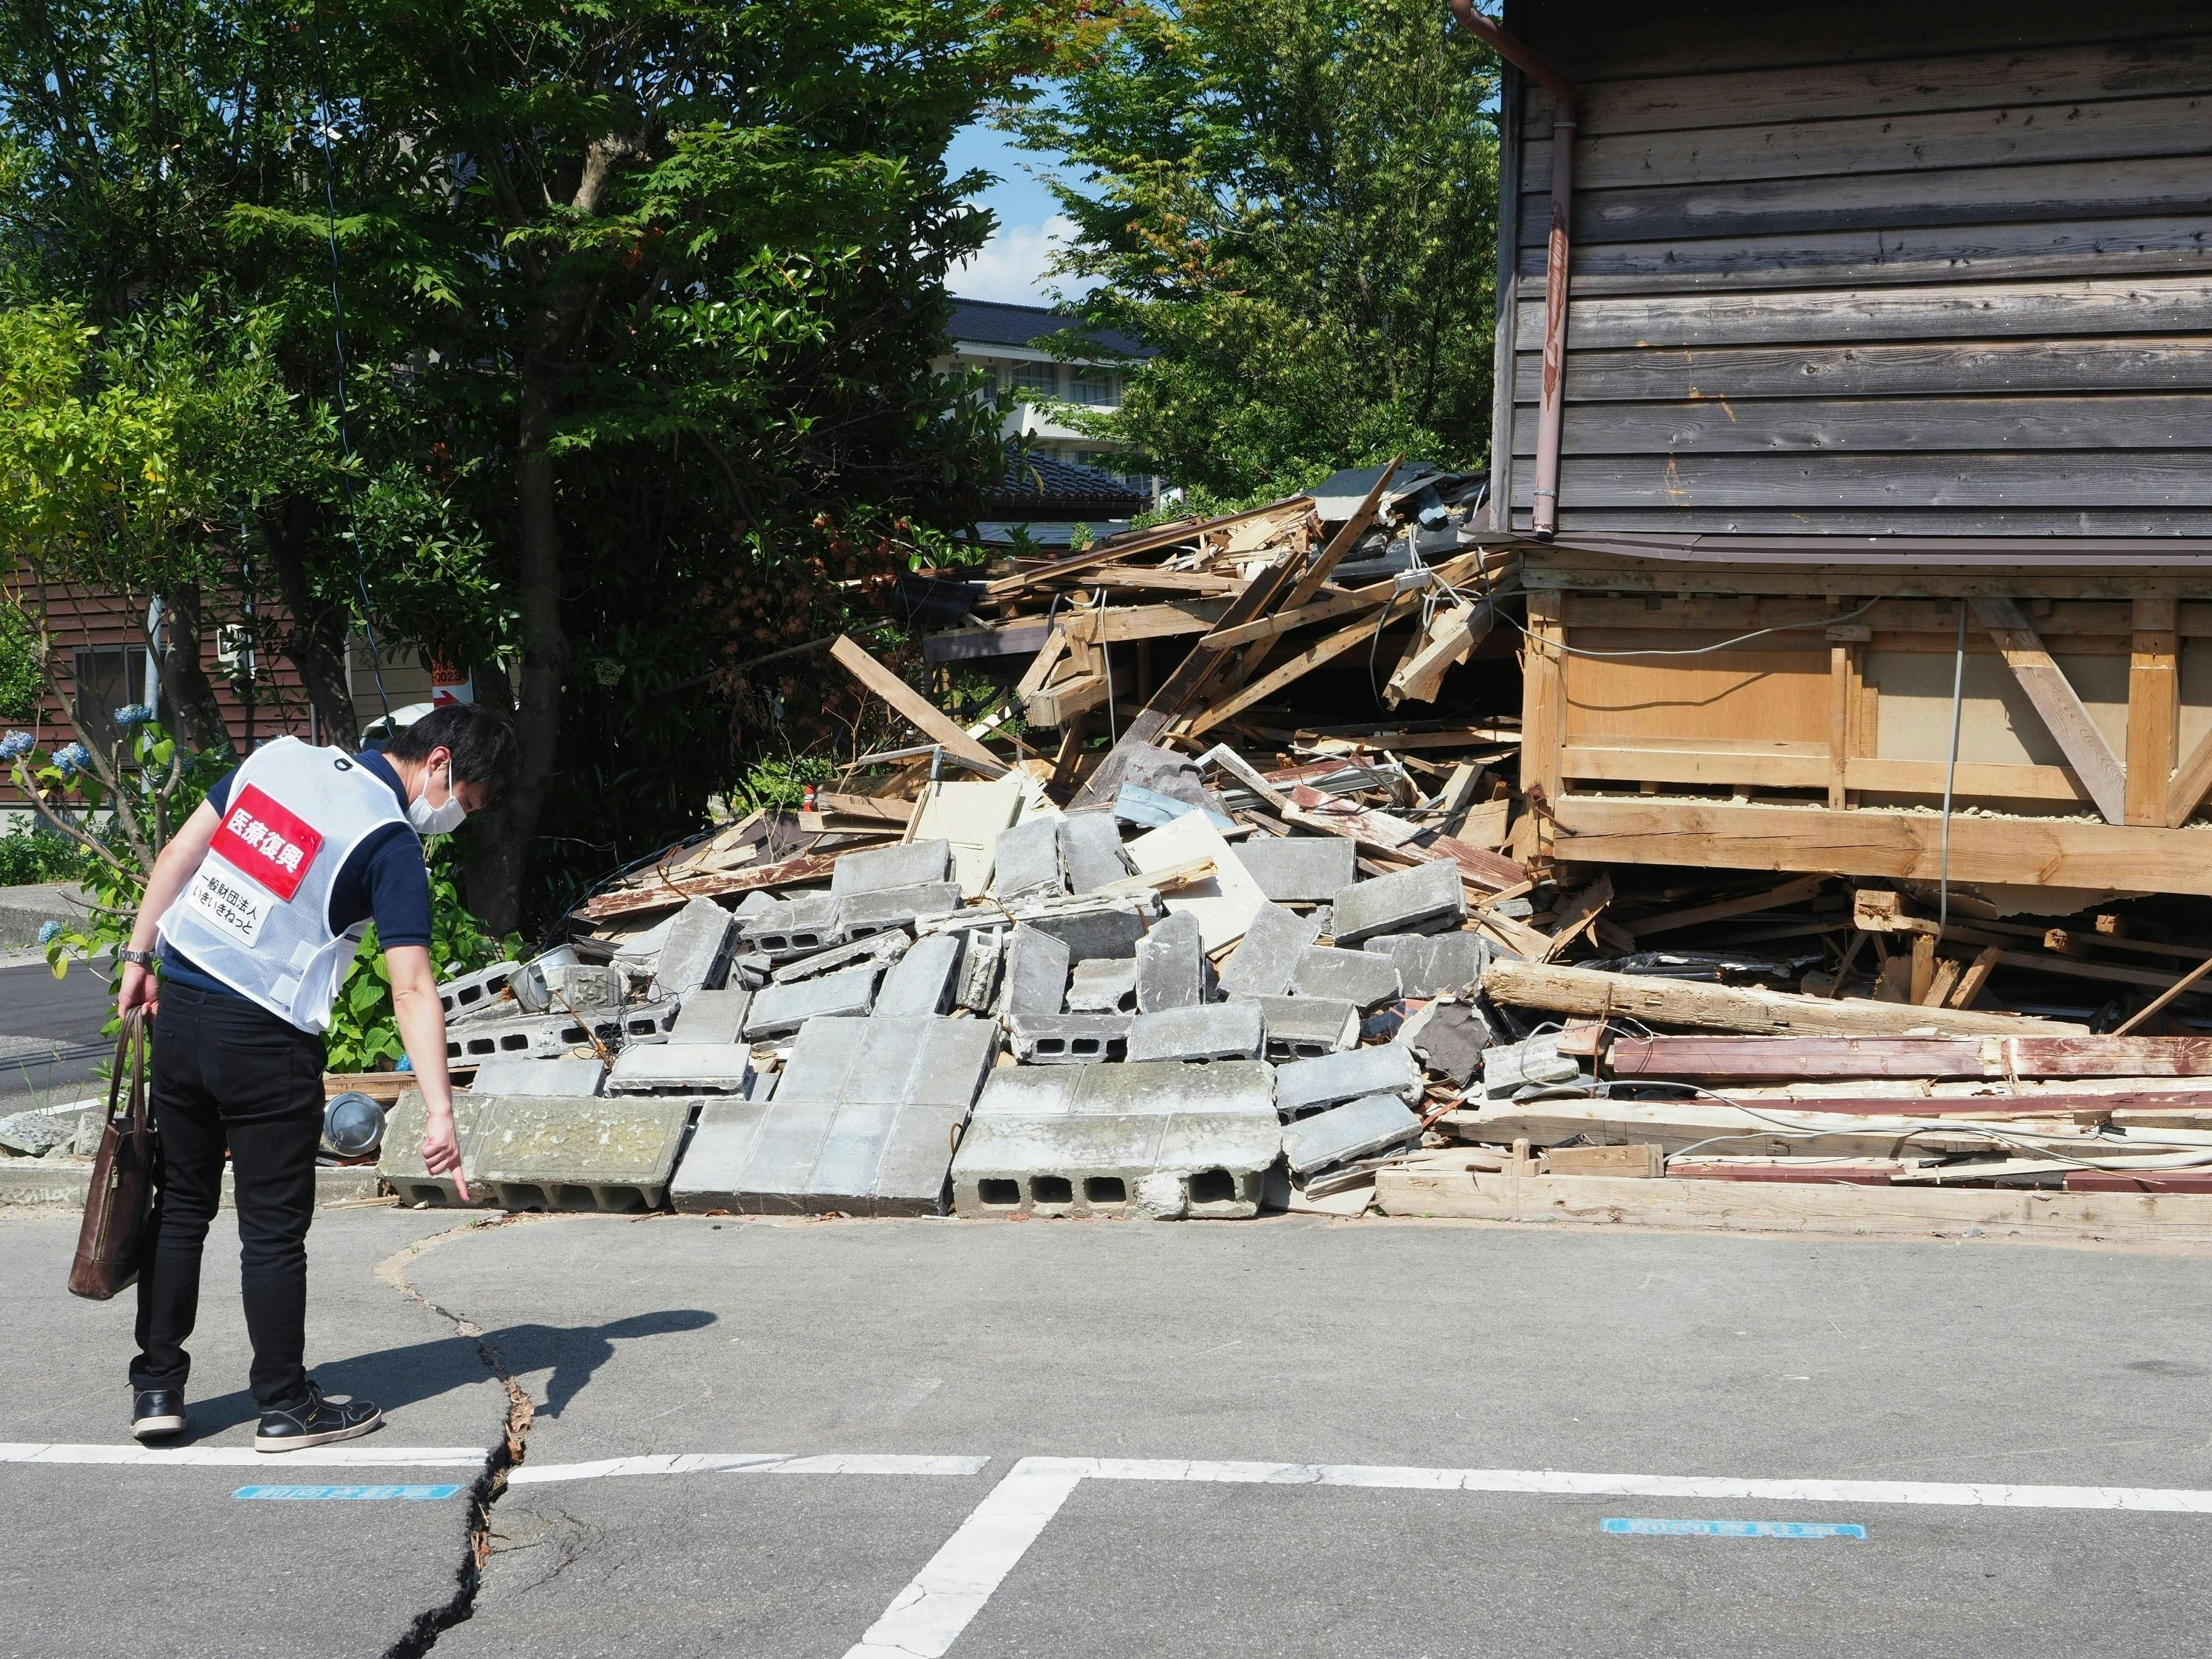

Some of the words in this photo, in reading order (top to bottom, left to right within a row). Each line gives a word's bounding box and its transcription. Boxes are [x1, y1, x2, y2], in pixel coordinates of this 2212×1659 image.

[226, 807, 305, 873] 医療復興
[193, 886, 253, 935] いきいきねっと
[201, 874, 257, 920] 一般財団法人
